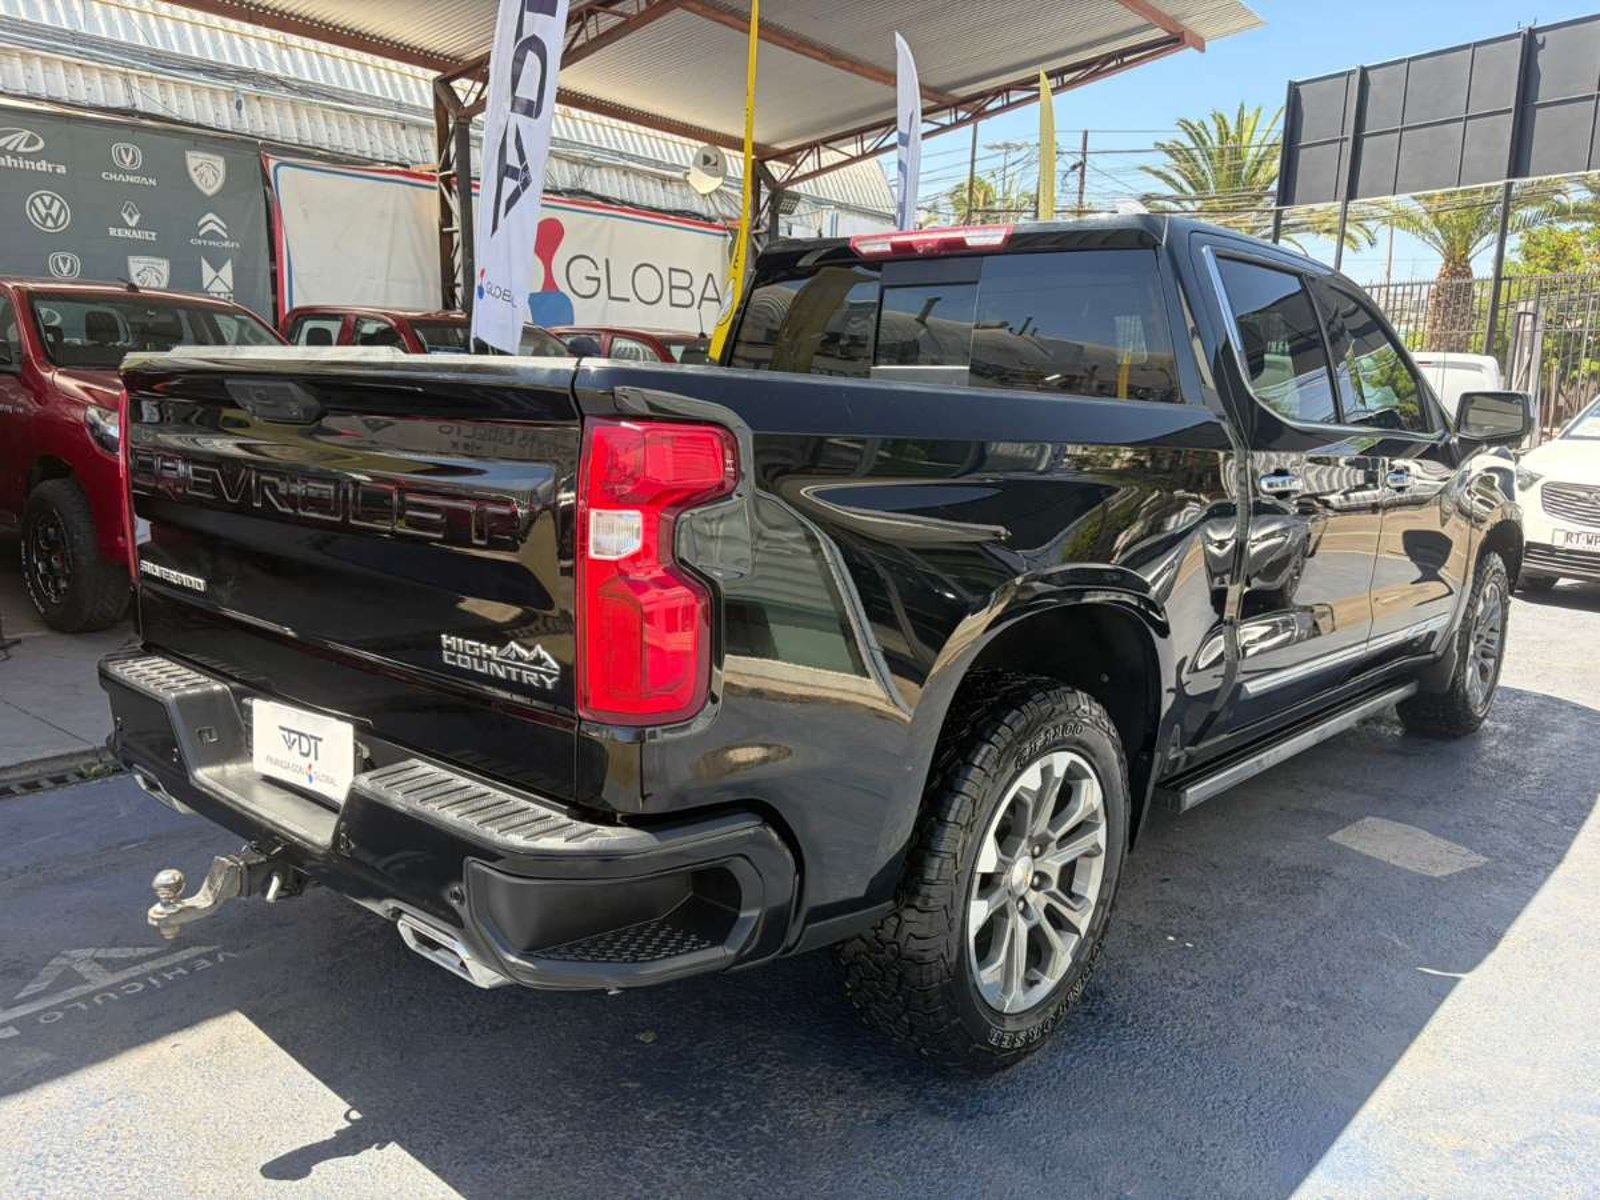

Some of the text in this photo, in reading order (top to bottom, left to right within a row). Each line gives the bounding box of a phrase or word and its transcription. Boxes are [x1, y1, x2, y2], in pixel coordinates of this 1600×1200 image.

[0, 155, 67, 174] ahindra
[101, 171, 157, 186] CHANGAN
[108, 227, 157, 241] RENAULT
[566, 254, 722, 309] GLOBA
[441, 634, 499, 660] HIGH
[442, 650, 559, 690] COUNTRY
[37, 951, 238, 1024] VEHICULO
